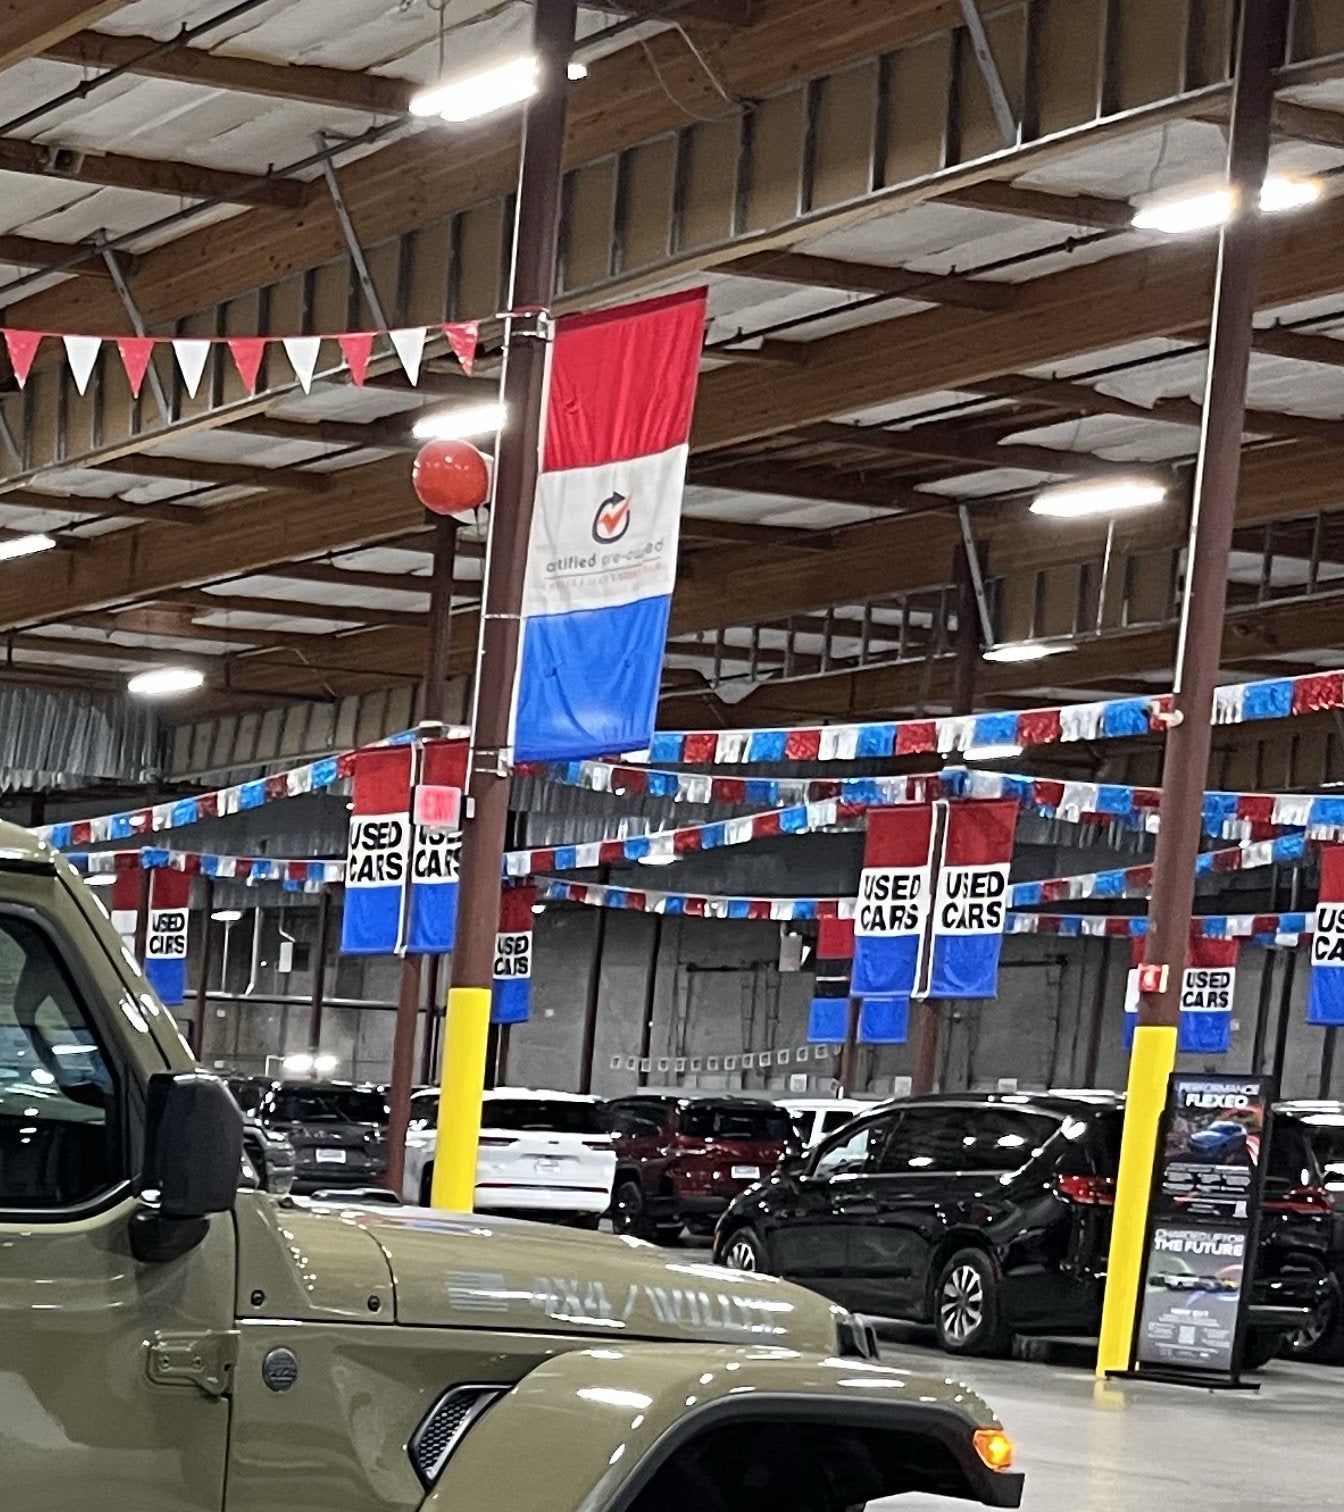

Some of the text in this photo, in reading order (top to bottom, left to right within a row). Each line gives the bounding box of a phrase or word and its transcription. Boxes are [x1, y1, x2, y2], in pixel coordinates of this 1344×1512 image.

[350, 820, 403, 850] USED
[349, 851, 403, 882] CARS
[864, 873, 921, 901] USED
[946, 870, 1005, 899] USED
[153, 912, 186, 933] USED
[861, 903, 919, 931] CARS
[941, 901, 1003, 929] CARS
[1186, 971, 1231, 988] USED
[1182, 991, 1229, 1008] CARS
[1186, 1093, 1250, 1109] FLEXED
[1154, 1237, 1244, 1258] THE FUTURE
